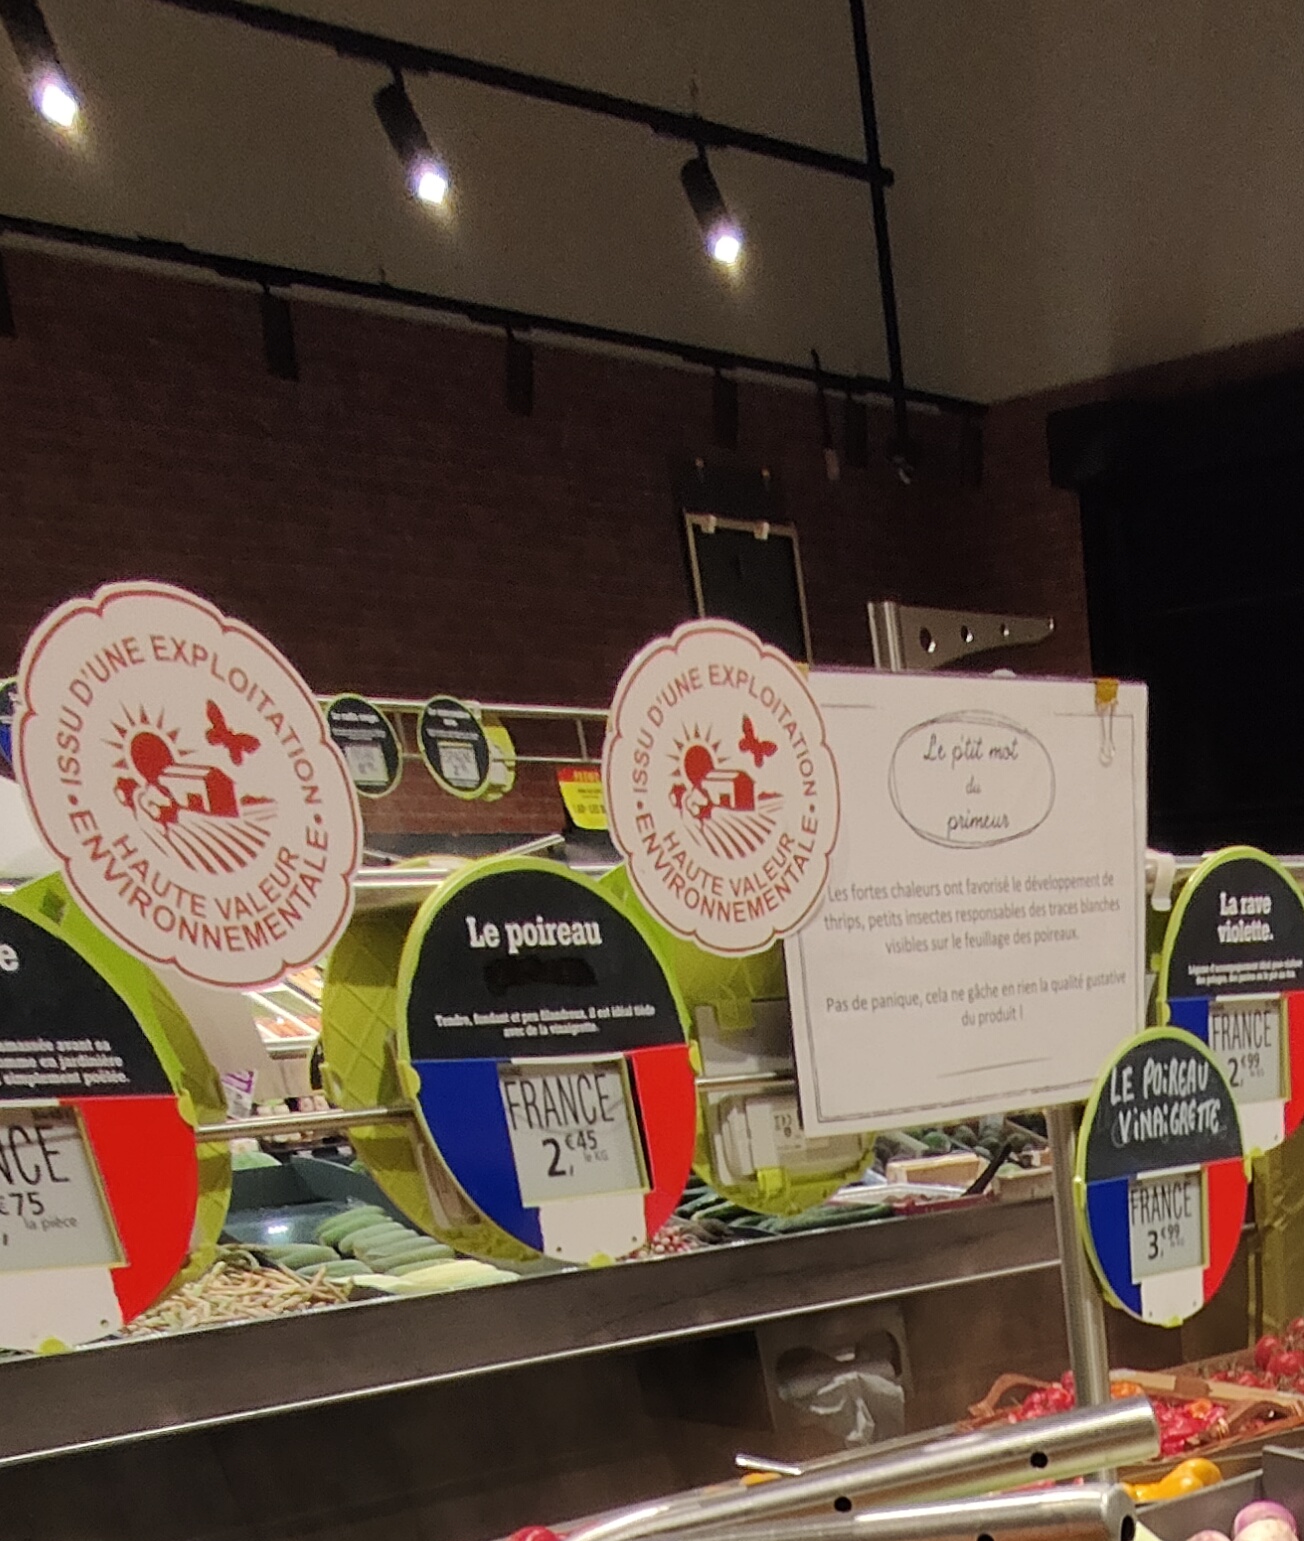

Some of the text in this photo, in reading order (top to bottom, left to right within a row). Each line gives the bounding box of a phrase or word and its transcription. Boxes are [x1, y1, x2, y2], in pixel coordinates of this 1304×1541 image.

[69, 637, 145, 707] D'UNE
[150, 634, 323, 805] EXPLOITATION
[632, 664, 816, 796] ISSU D'UNE EXPLOITATION
[58, 706, 84, 786] ISSU
[923, 733, 946, 761] Le
[989, 736, 1019, 761] mot
[965, 775, 982, 794] du
[946, 808, 1010, 840] primeur
[68, 809, 329, 952] ENVIRONNEMENTALE
[112, 834, 300, 921] HAUTE VALEUR
[635, 814, 819, 923] ENVIRONNEMENTALE
[664, 831, 795, 898] HAUTE VALEUR
[828, 870, 1114, 902] Les fortes chaleurs ont favorisé le développement de
[824, 896, 1121, 932] thrips, petits insectes responsables des traces blanches
[1220, 891, 1272, 916] La rave
[465, 915, 603, 955] Le poireau
[885, 926, 1079, 954] visibles sur le feuillage des poireaux.
[1217, 919, 1274, 943] violette.
[826, 970, 1126, 1013] Pas de panique, cela ne gâche en rien la qualité gustative
[961, 1010, 975, 1027] du
[978, 1006, 1017, 1027] produit
[1212, 1010, 1272, 1053] FRANCE
[504, 1073, 615, 1130] FRANCE
[1111, 1066, 1134, 1106] LE
[1131, 1180, 1192, 1227] FRANCE
